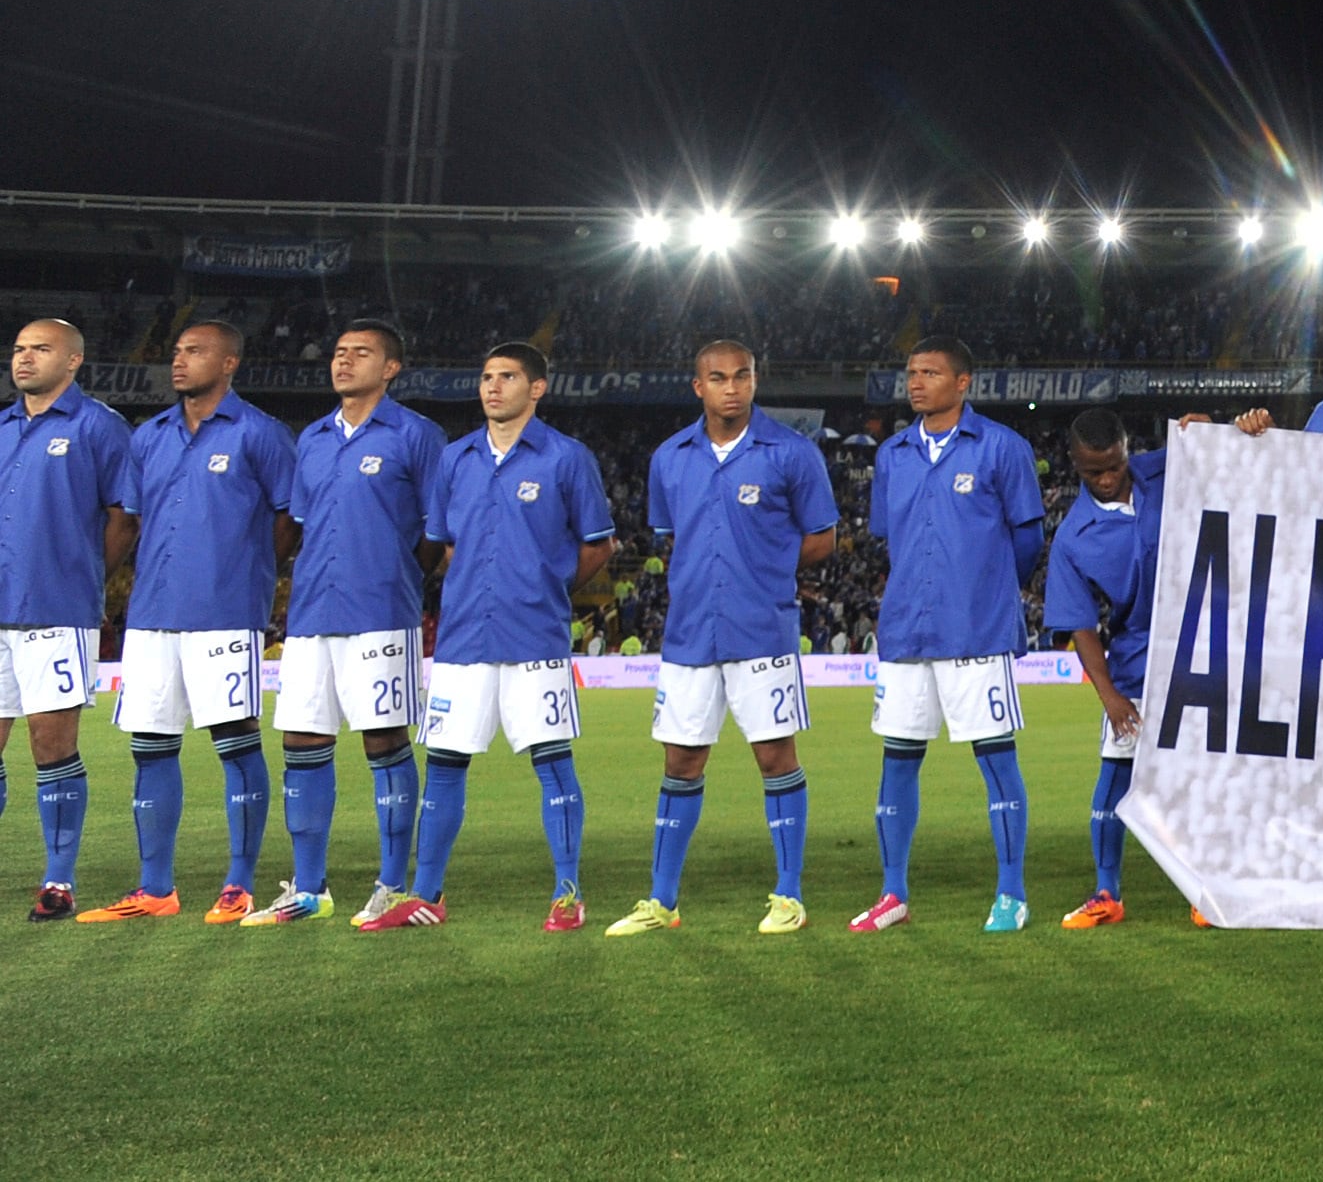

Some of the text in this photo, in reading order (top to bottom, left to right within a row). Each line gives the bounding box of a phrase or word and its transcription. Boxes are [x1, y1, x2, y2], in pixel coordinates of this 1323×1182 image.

[79, 365, 152, 391] AZUL
[547, 372, 642, 397] ILLOS
[1006, 372, 1082, 401] BUFALO
[208, 647, 224, 658] LG
[362, 644, 403, 660] LG G2
[751, 656, 791, 674] LG G2
[53, 658, 74, 693] 5
[372, 676, 403, 716] 26
[543, 688, 568, 726] 32
[988, 686, 1005, 722] 6
